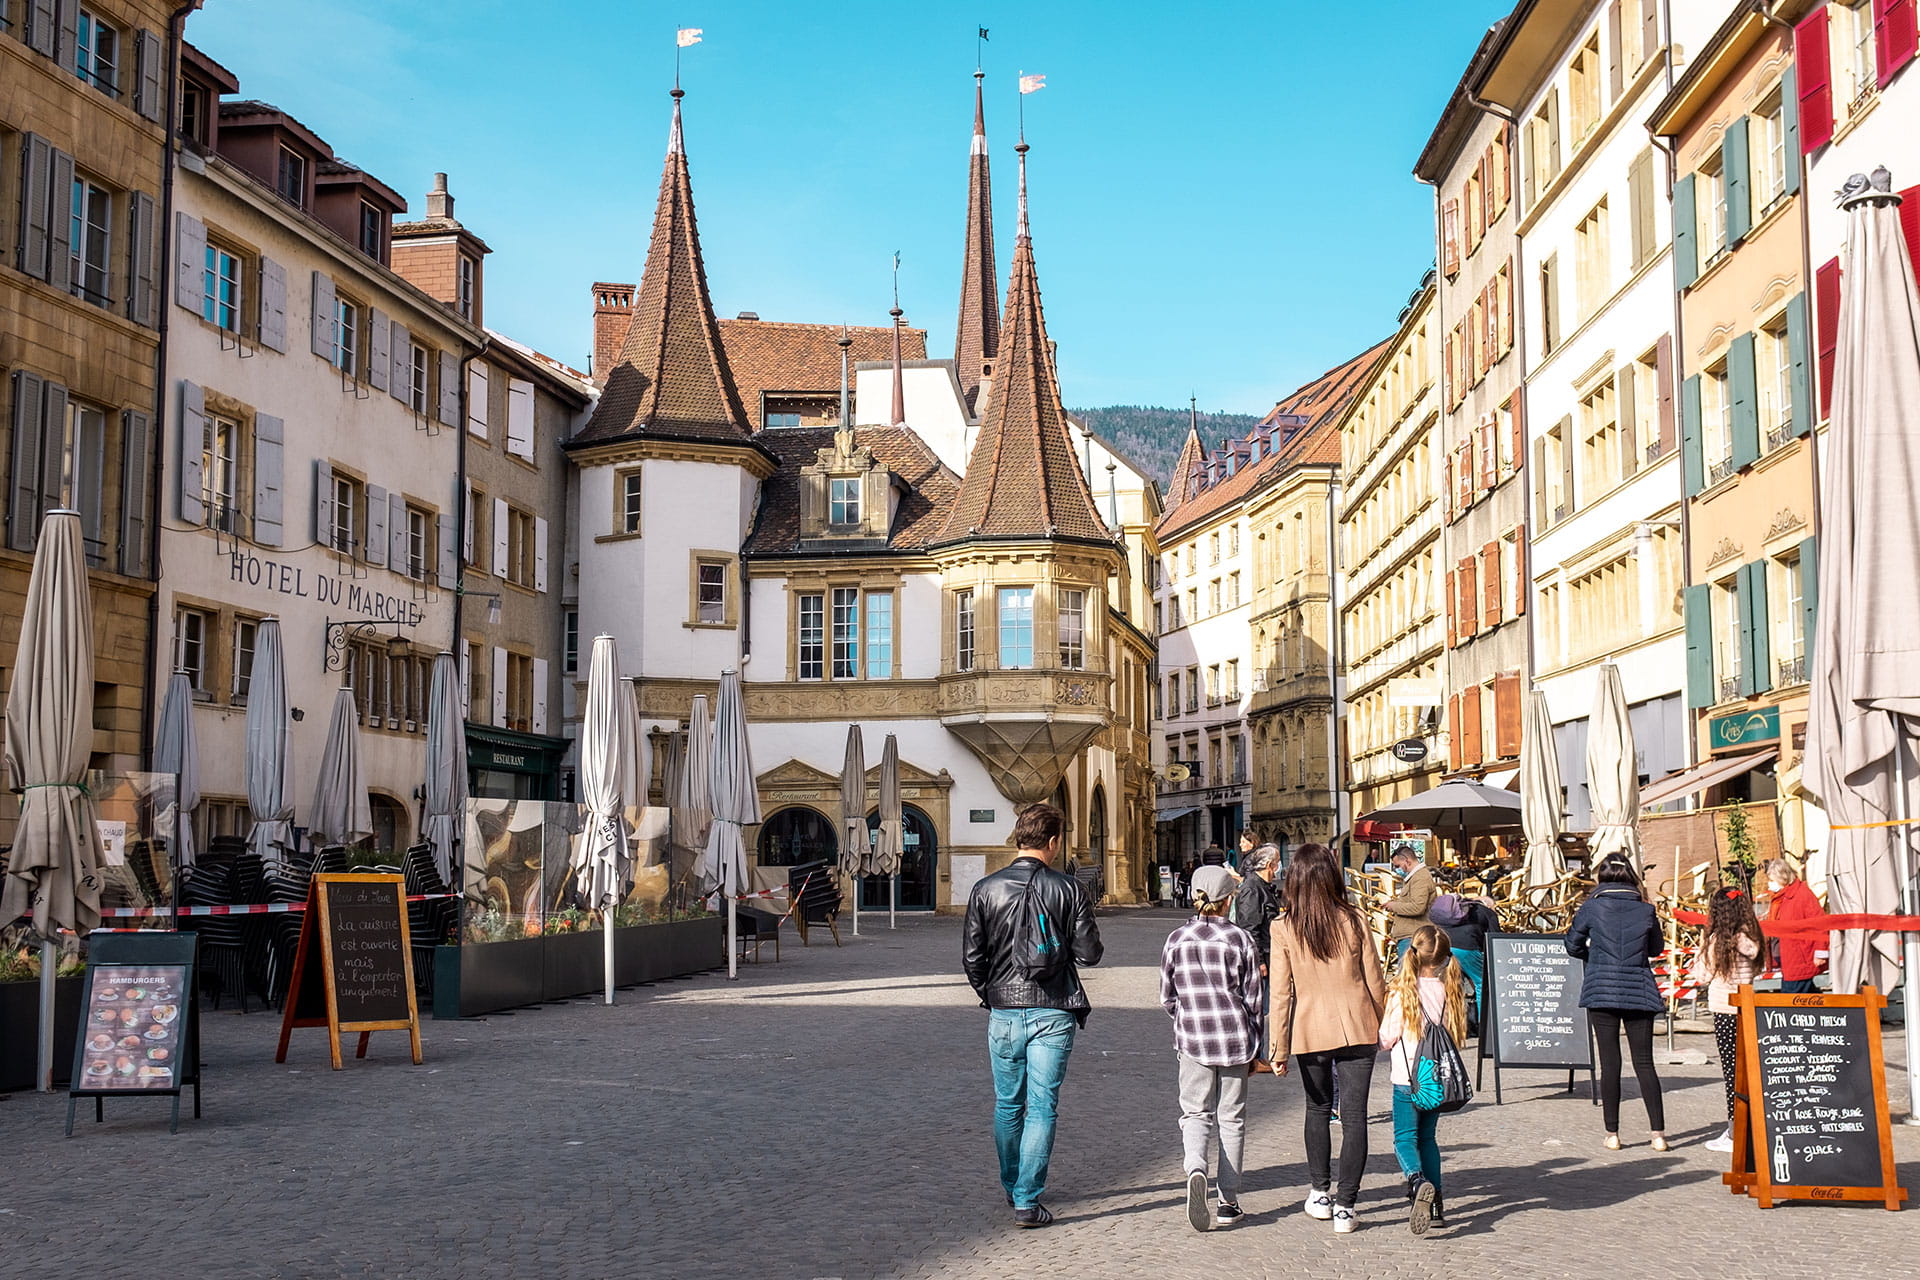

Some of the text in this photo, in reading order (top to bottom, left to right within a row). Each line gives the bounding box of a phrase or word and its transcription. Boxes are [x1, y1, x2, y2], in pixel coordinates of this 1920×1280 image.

[229, 551, 308, 597] HOTEL
[317, 574, 342, 606] DU
[493, 753, 525, 767] RESTAURANT
[768, 791, 820, 800] Restaurant
[337, 911, 400, 932] La cuisine
[340, 938, 399, 951] est ouverte
[1511, 942, 1527, 954] VIN
[344, 955, 374, 970] mais
[109, 976, 166, 985] HAMBURGERS
[1763, 1010, 1787, 1029] VIN
[1789, 1013, 1816, 1027] CHAUD
